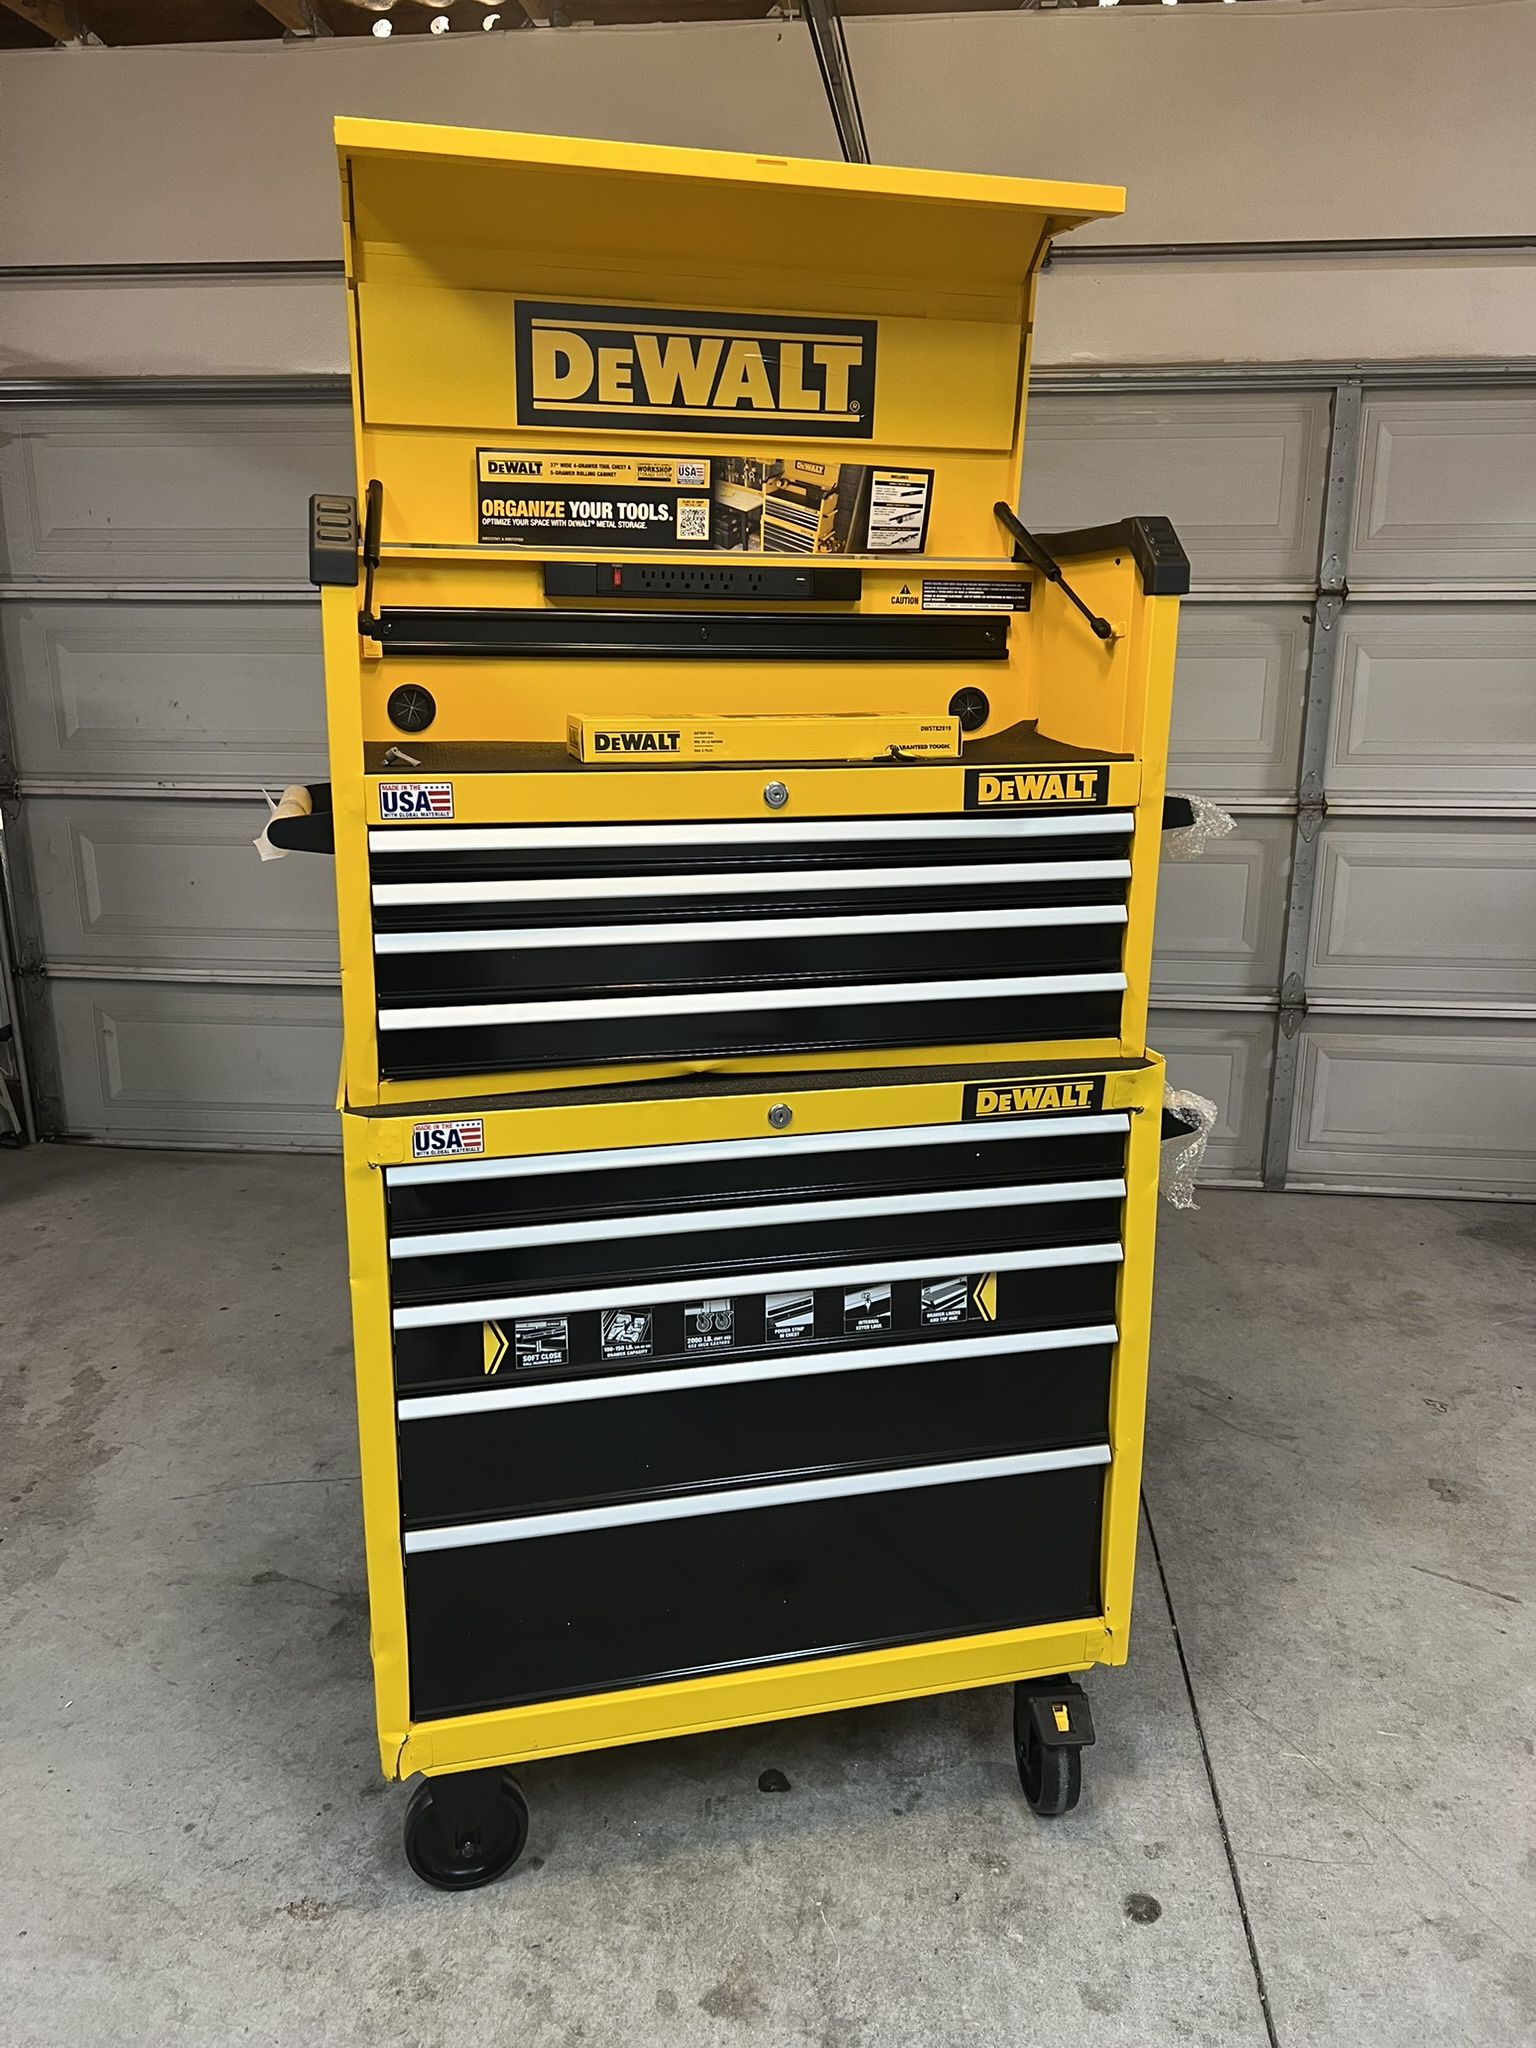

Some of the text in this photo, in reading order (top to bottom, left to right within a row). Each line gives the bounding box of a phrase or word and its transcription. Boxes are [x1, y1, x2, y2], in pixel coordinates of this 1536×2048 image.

[488, 461, 542, 475] DEWALT
[678, 467, 697, 477] USA
[481, 499, 673, 522] ORGANIZE YOUR TOOLS.
[481, 518, 511, 526] OPTIMIZE
[512, 518, 529, 526] YOUR
[530, 519, 550, 527] SPACE
[550, 519, 567, 527] WITH
[596, 520, 617, 529] METAL
[618, 520, 648, 530] STORAGE.
[891, 596, 919, 605] CAUTION
[594, 734, 680, 751] DEWALT
[978, 773, 1098, 801] DEWALT
[382, 791, 432, 812] USA
[976, 1084, 1094, 1113] DEWALT
[415, 1129, 462, 1151] USA
[687, 1336, 703, 1344] 2000
[522, 1351, 562, 1363] SOFT CLOSE
